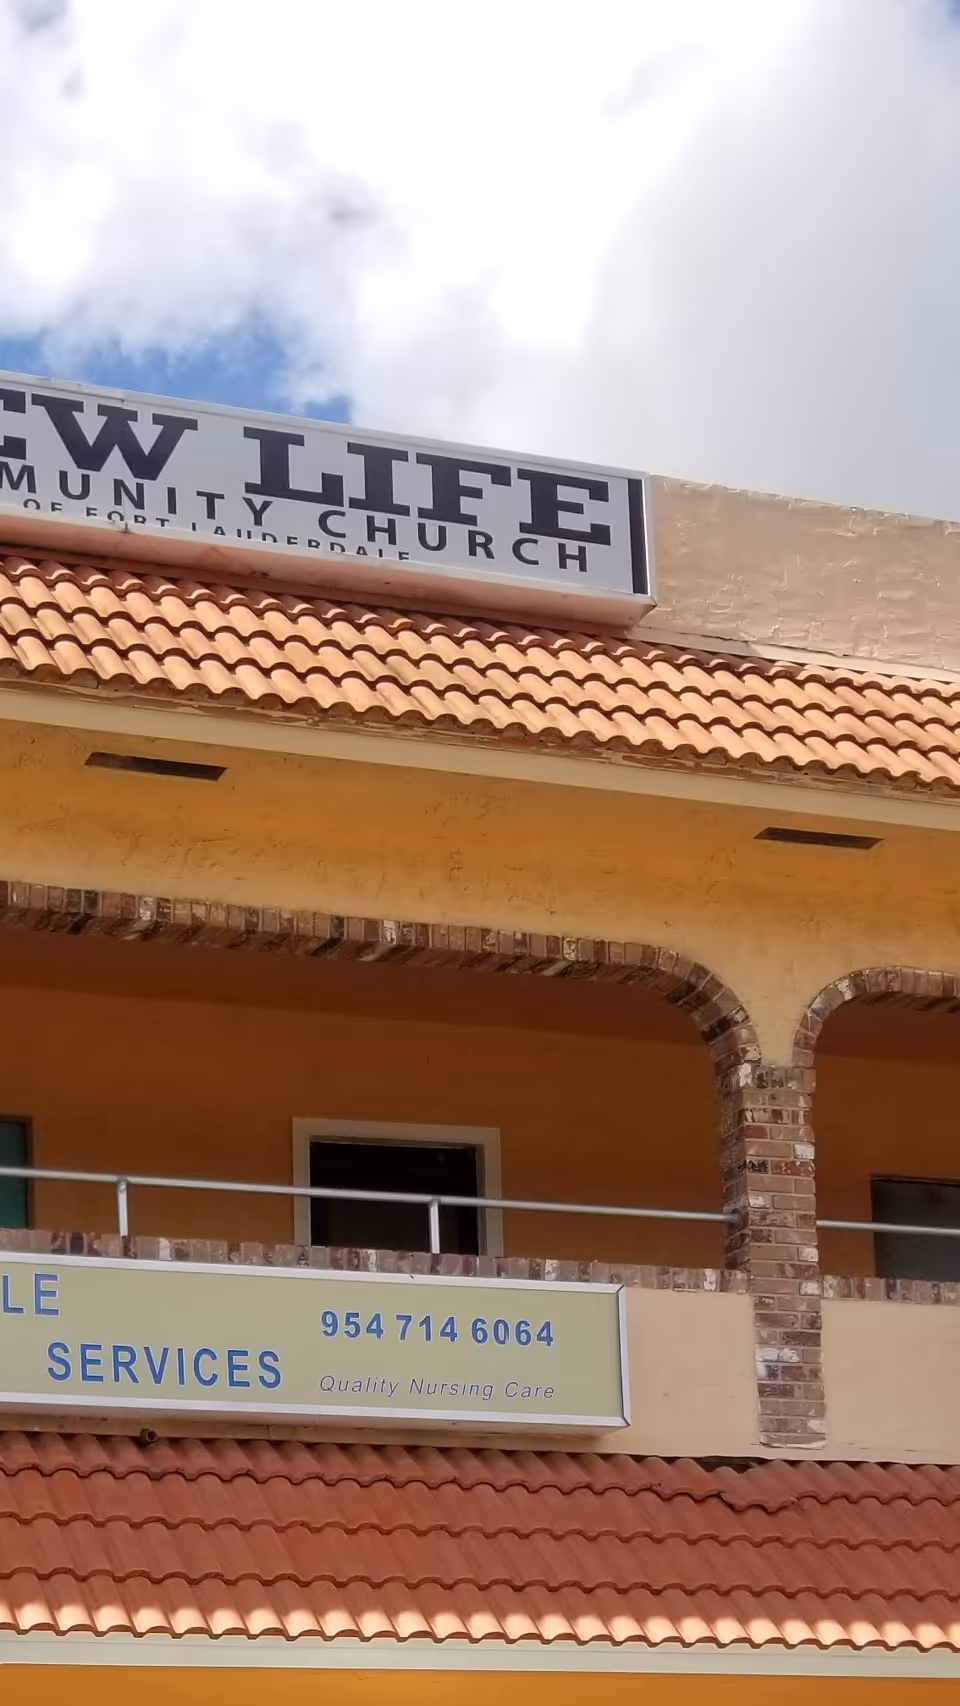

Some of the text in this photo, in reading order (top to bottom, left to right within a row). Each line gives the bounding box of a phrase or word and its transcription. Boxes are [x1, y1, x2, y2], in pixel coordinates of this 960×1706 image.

[243, 426, 612, 546] LIFE
[317, 509, 589, 573] CHURCH
[320, 1310, 554, 1348] 954 714 6064
[46, 1341, 282, 1389] SERVICES
[320, 1375, 555, 1401] Quality Nursing Care
